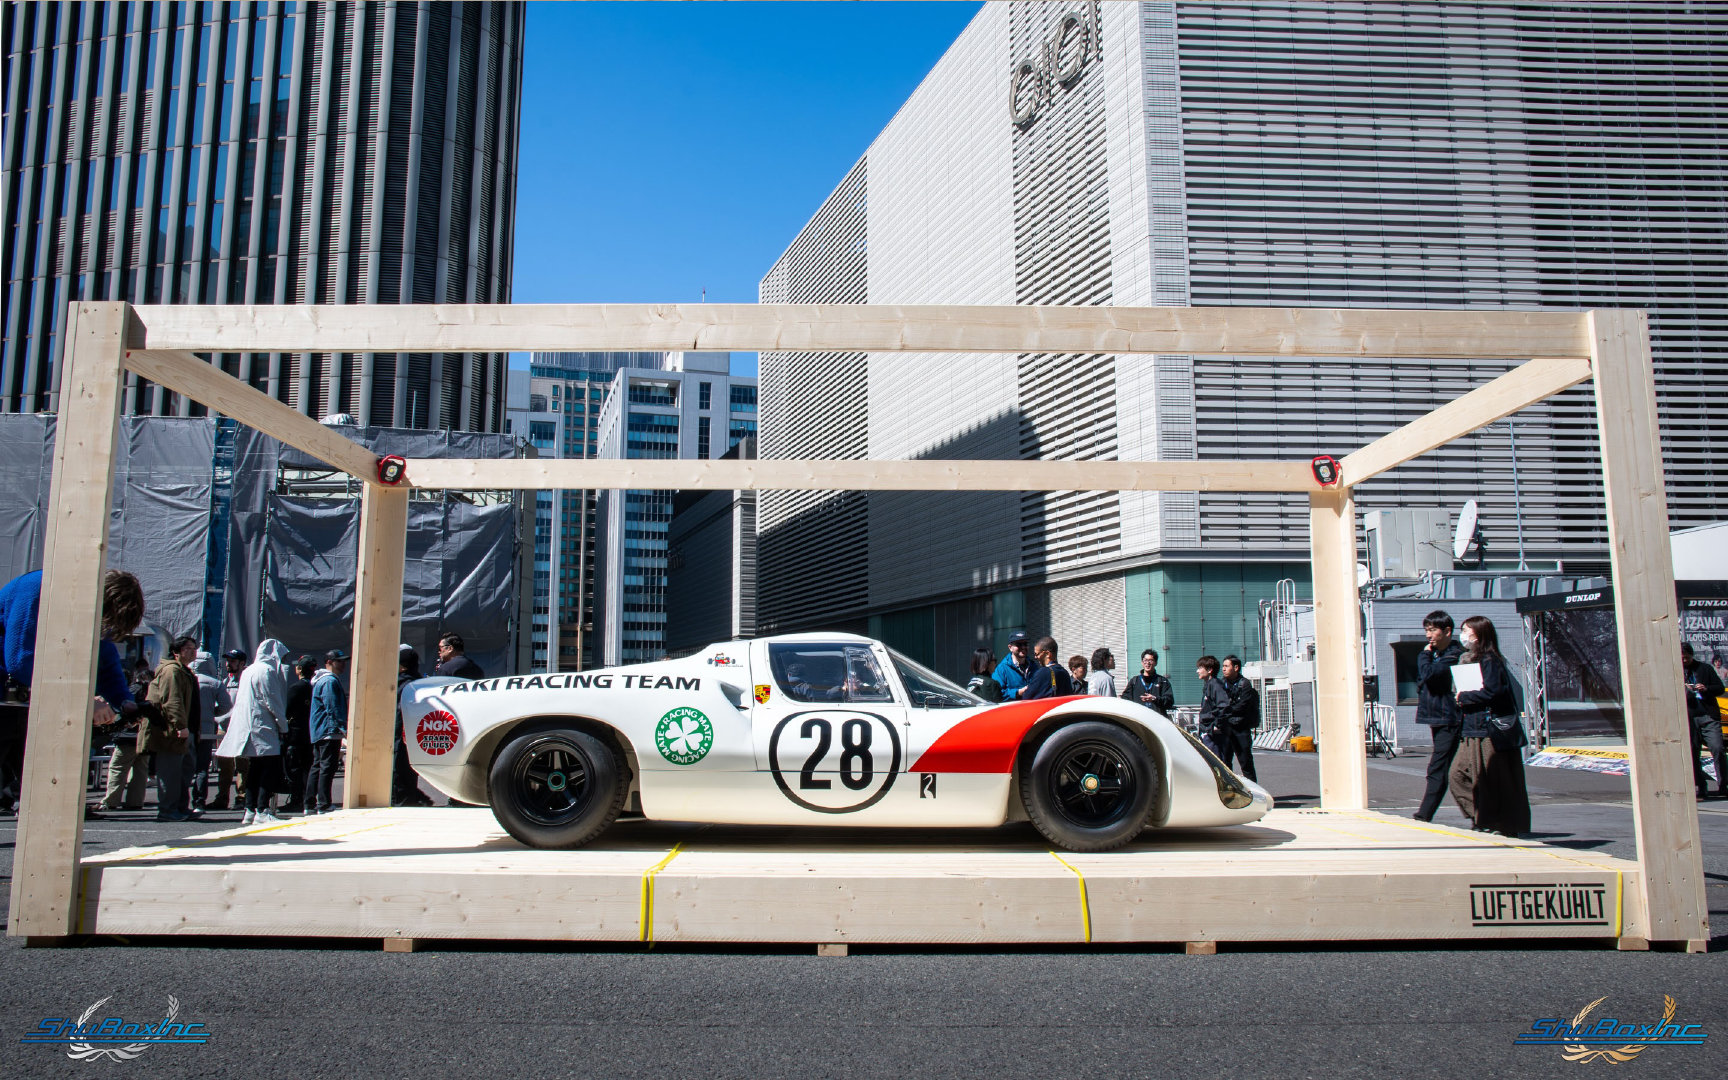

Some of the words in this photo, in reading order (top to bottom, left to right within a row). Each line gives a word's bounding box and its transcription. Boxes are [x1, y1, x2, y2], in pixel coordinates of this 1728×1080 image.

[1565, 592, 1601, 604] DUNLOP
[440, 678, 500, 696] TAKI
[505, 675, 614, 690] RACING
[622, 675, 701, 691] TEAM
[422, 719, 452, 732] NGK
[664, 709, 697, 725] RACING
[698, 716, 712, 741] MATE
[658, 730, 671, 755] MATE
[672, 747, 706, 763] RACING
[800, 718, 874, 791] 28
[1470, 883, 1606, 920] LUFTGEKÜHLT
